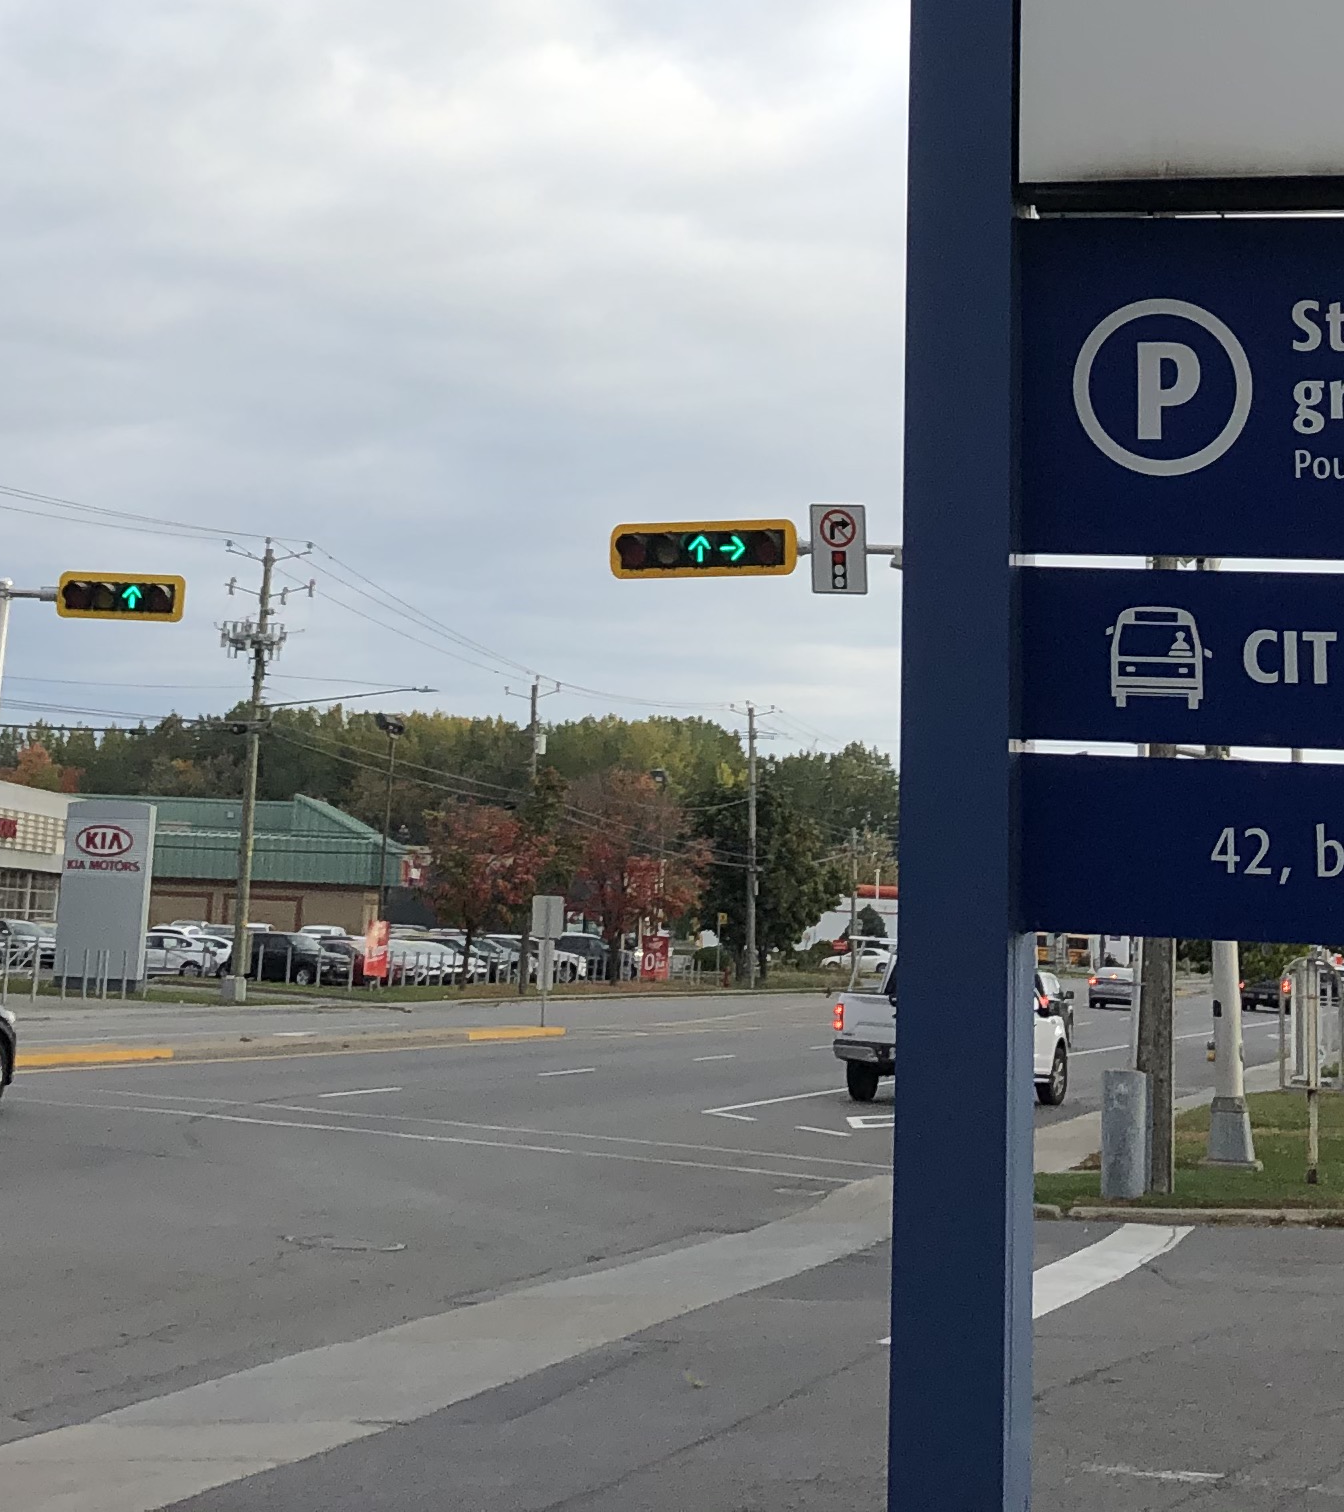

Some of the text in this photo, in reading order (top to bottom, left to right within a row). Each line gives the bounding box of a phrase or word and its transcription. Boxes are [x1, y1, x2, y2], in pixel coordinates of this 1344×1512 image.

[1136, 341, 1201, 440] P
[1243, 629, 1338, 685] CIT
[67, 859, 141, 872] KIA MOTORS
[85, 831, 123, 850] KIA
[1210, 827, 1292, 885] 42,
